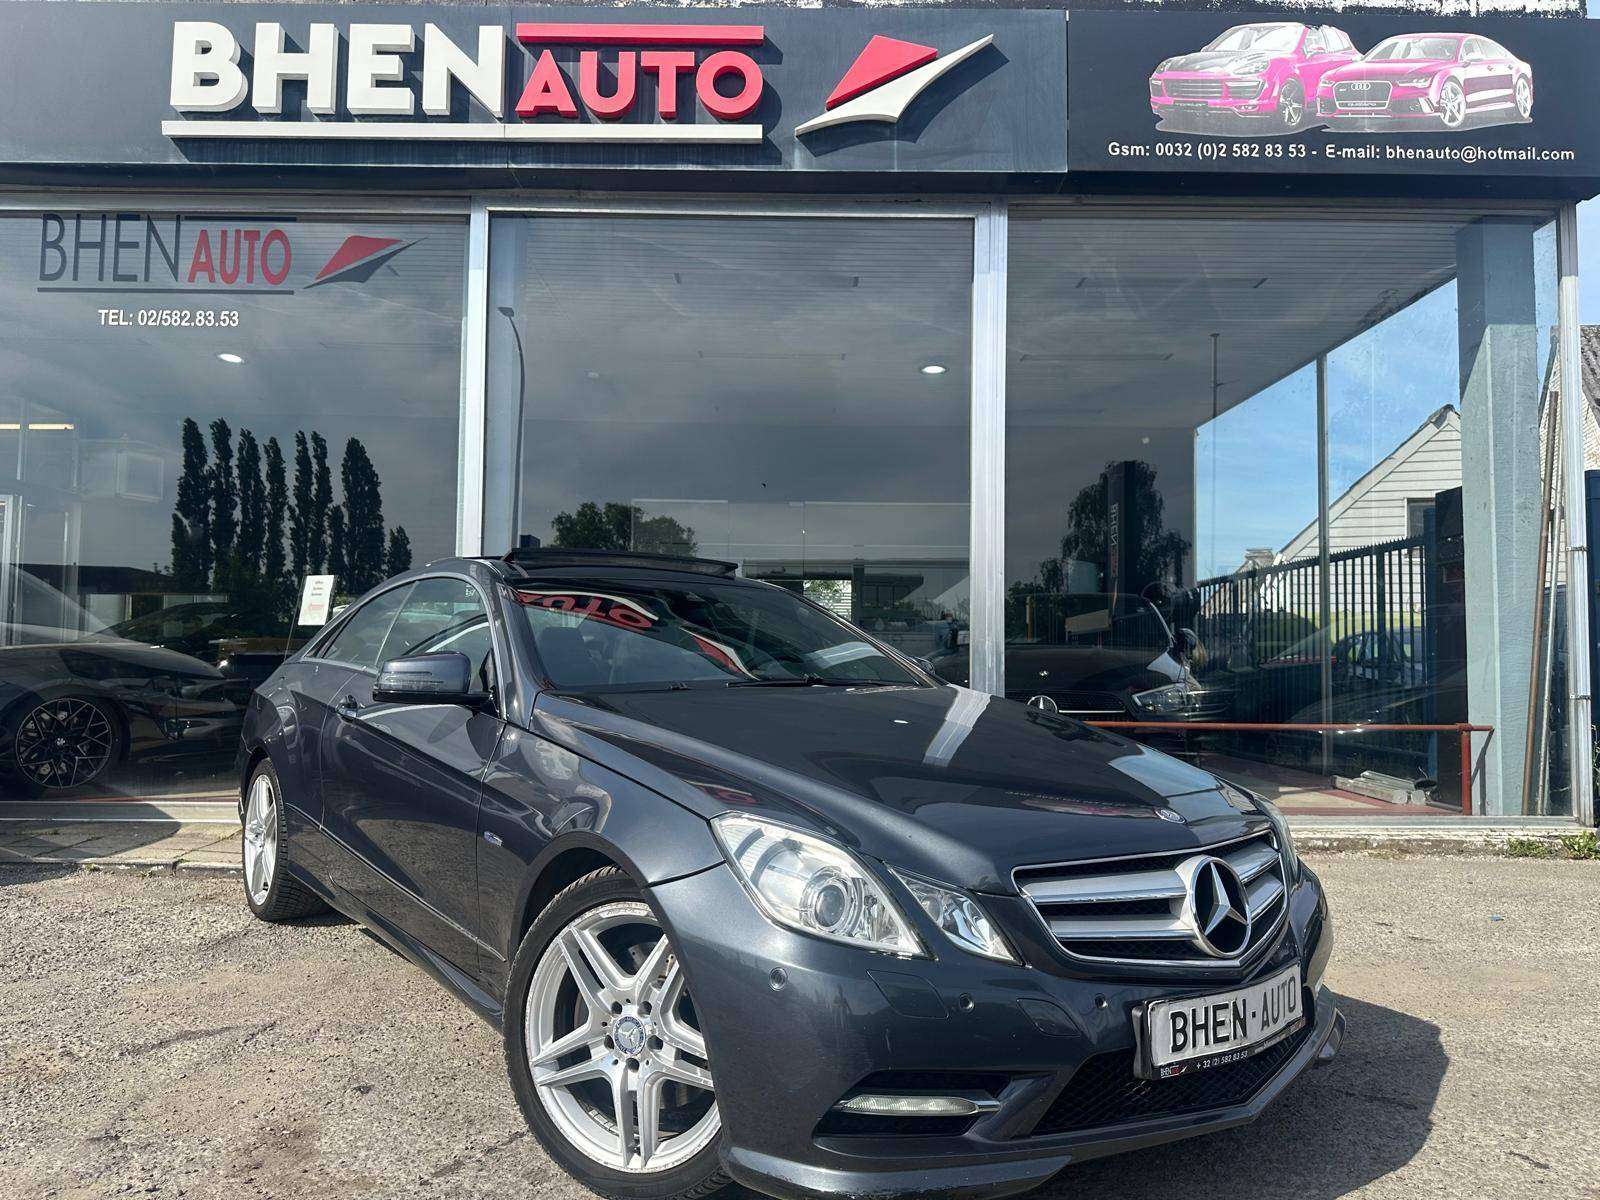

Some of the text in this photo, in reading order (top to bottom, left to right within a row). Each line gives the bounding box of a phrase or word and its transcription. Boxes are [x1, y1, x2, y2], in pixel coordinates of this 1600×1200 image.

[170, 21, 764, 121] BHEN AUTO
[1107, 141, 1150, 157] Gsm:
[1155, 142, 1193, 157] 0032
[1197, 142, 1227, 161] (0)2
[1231, 143, 1260, 158] 582
[1264, 143, 1284, 158] 83
[1288, 143, 1307, 158] 53
[1325, 143, 1380, 159] E-mail:
[1385, 144, 1575, 164] bhenauto@hotmail.com
[39, 213, 292, 285] BHEN AUTO
[98, 309, 239, 327] TEL: 02/582.83.53
[1221, 1054, 1232, 1064] 582
